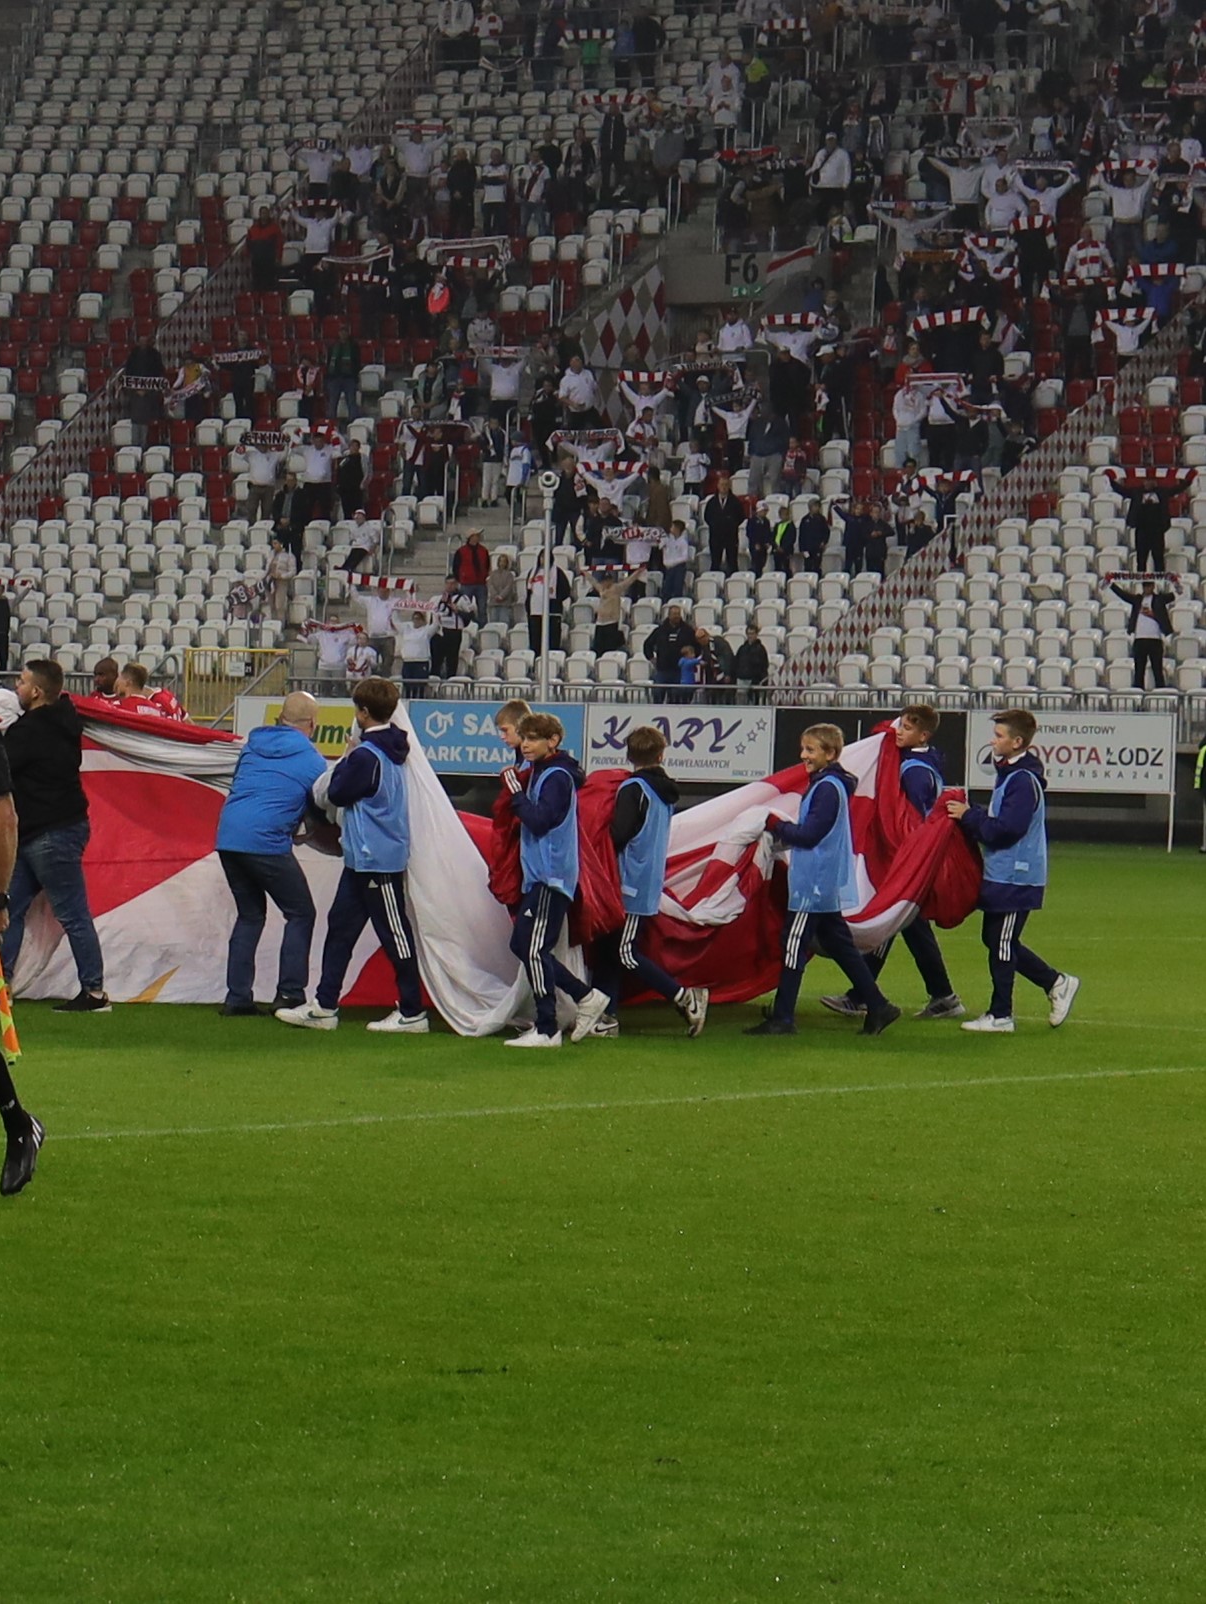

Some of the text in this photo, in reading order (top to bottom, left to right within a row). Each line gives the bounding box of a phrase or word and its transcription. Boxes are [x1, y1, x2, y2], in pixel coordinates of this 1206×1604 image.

[724, 253, 759, 285] F6
[592, 715, 743, 753] KARY
[1037, 725, 1116, 735] RTNER FLOTOWY
[1026, 745, 1101, 765] OYOTA
